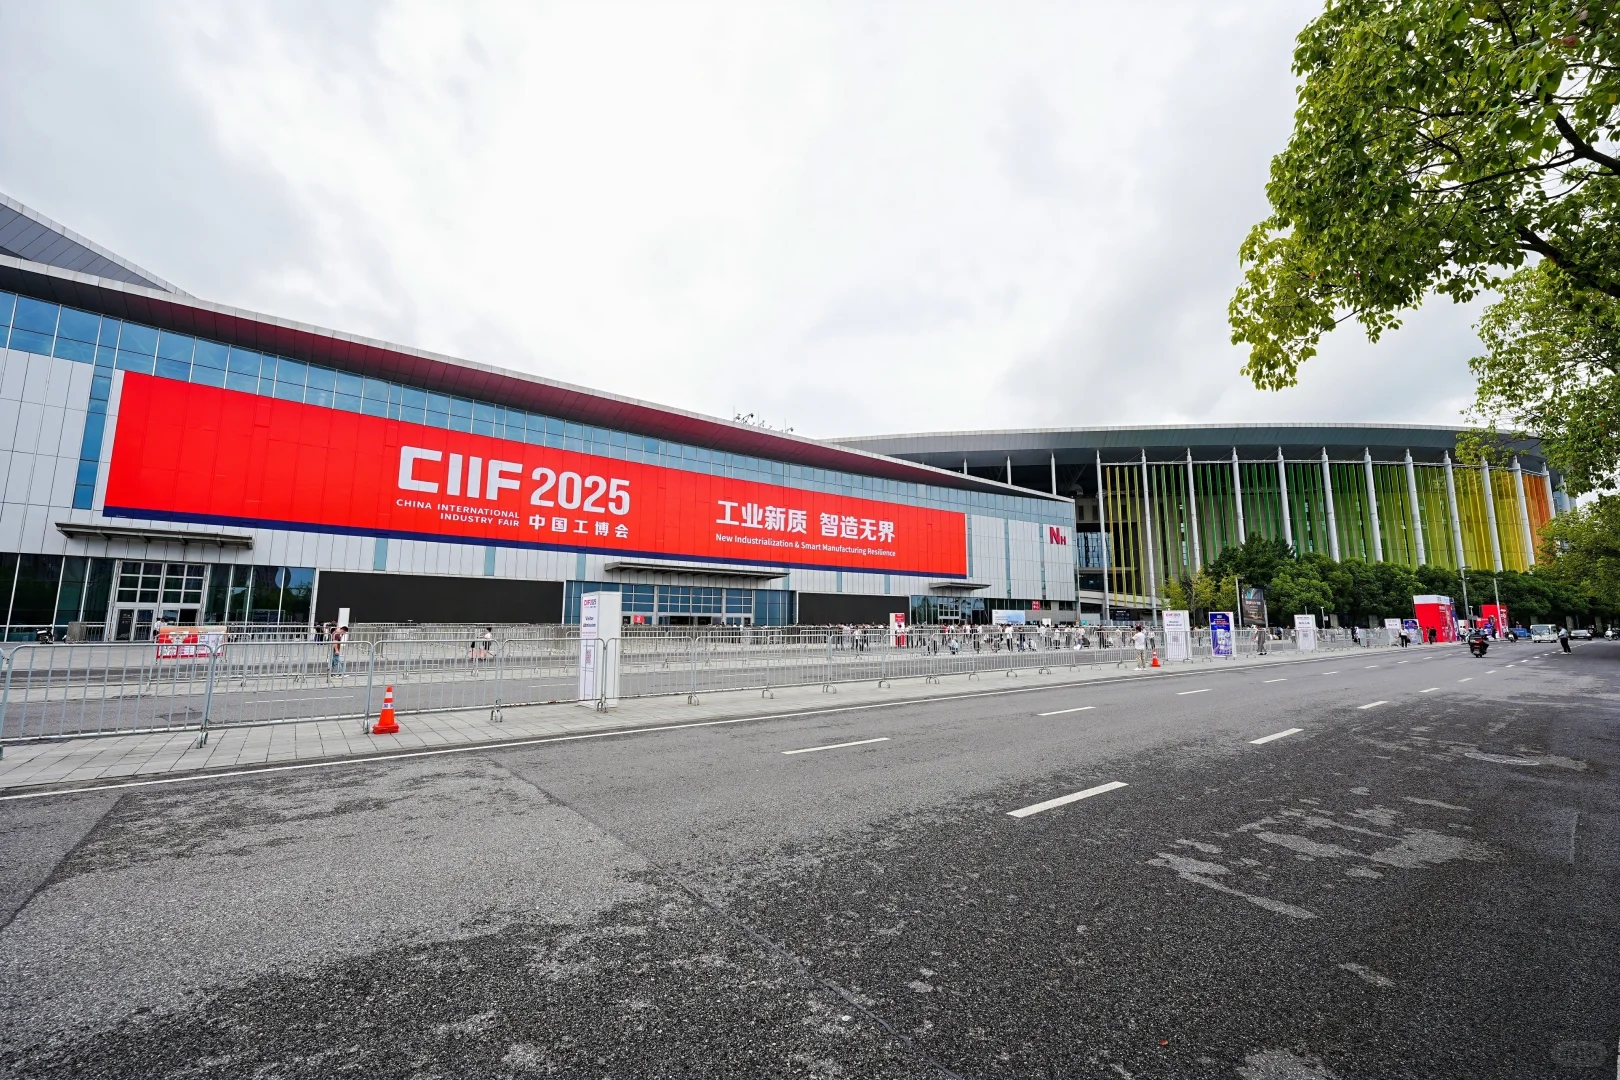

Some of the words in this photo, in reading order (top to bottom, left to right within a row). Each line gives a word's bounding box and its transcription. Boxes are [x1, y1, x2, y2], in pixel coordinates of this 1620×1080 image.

[397, 445, 524, 501] CIIF
[529, 466, 631, 516] 2025
[396, 498, 432, 510] CHINA
[437, 503, 520, 519] INTERNATIONAL
[440, 512, 494, 524] INDUSTRY
[497, 518, 520, 527] FAIR
[715, 500, 808, 535] 工业新质
[819, 511, 896, 542] 智造无界
[528, 513, 629, 539] 中国工博会
[715, 533, 734, 543] New
[734, 535, 794, 548] Industrialization
[794, 540, 801, 549] &
[800, 541, 822, 551] Smart
[821, 543, 867, 557] Manufacturing
[867, 547, 897, 557] Resilience
